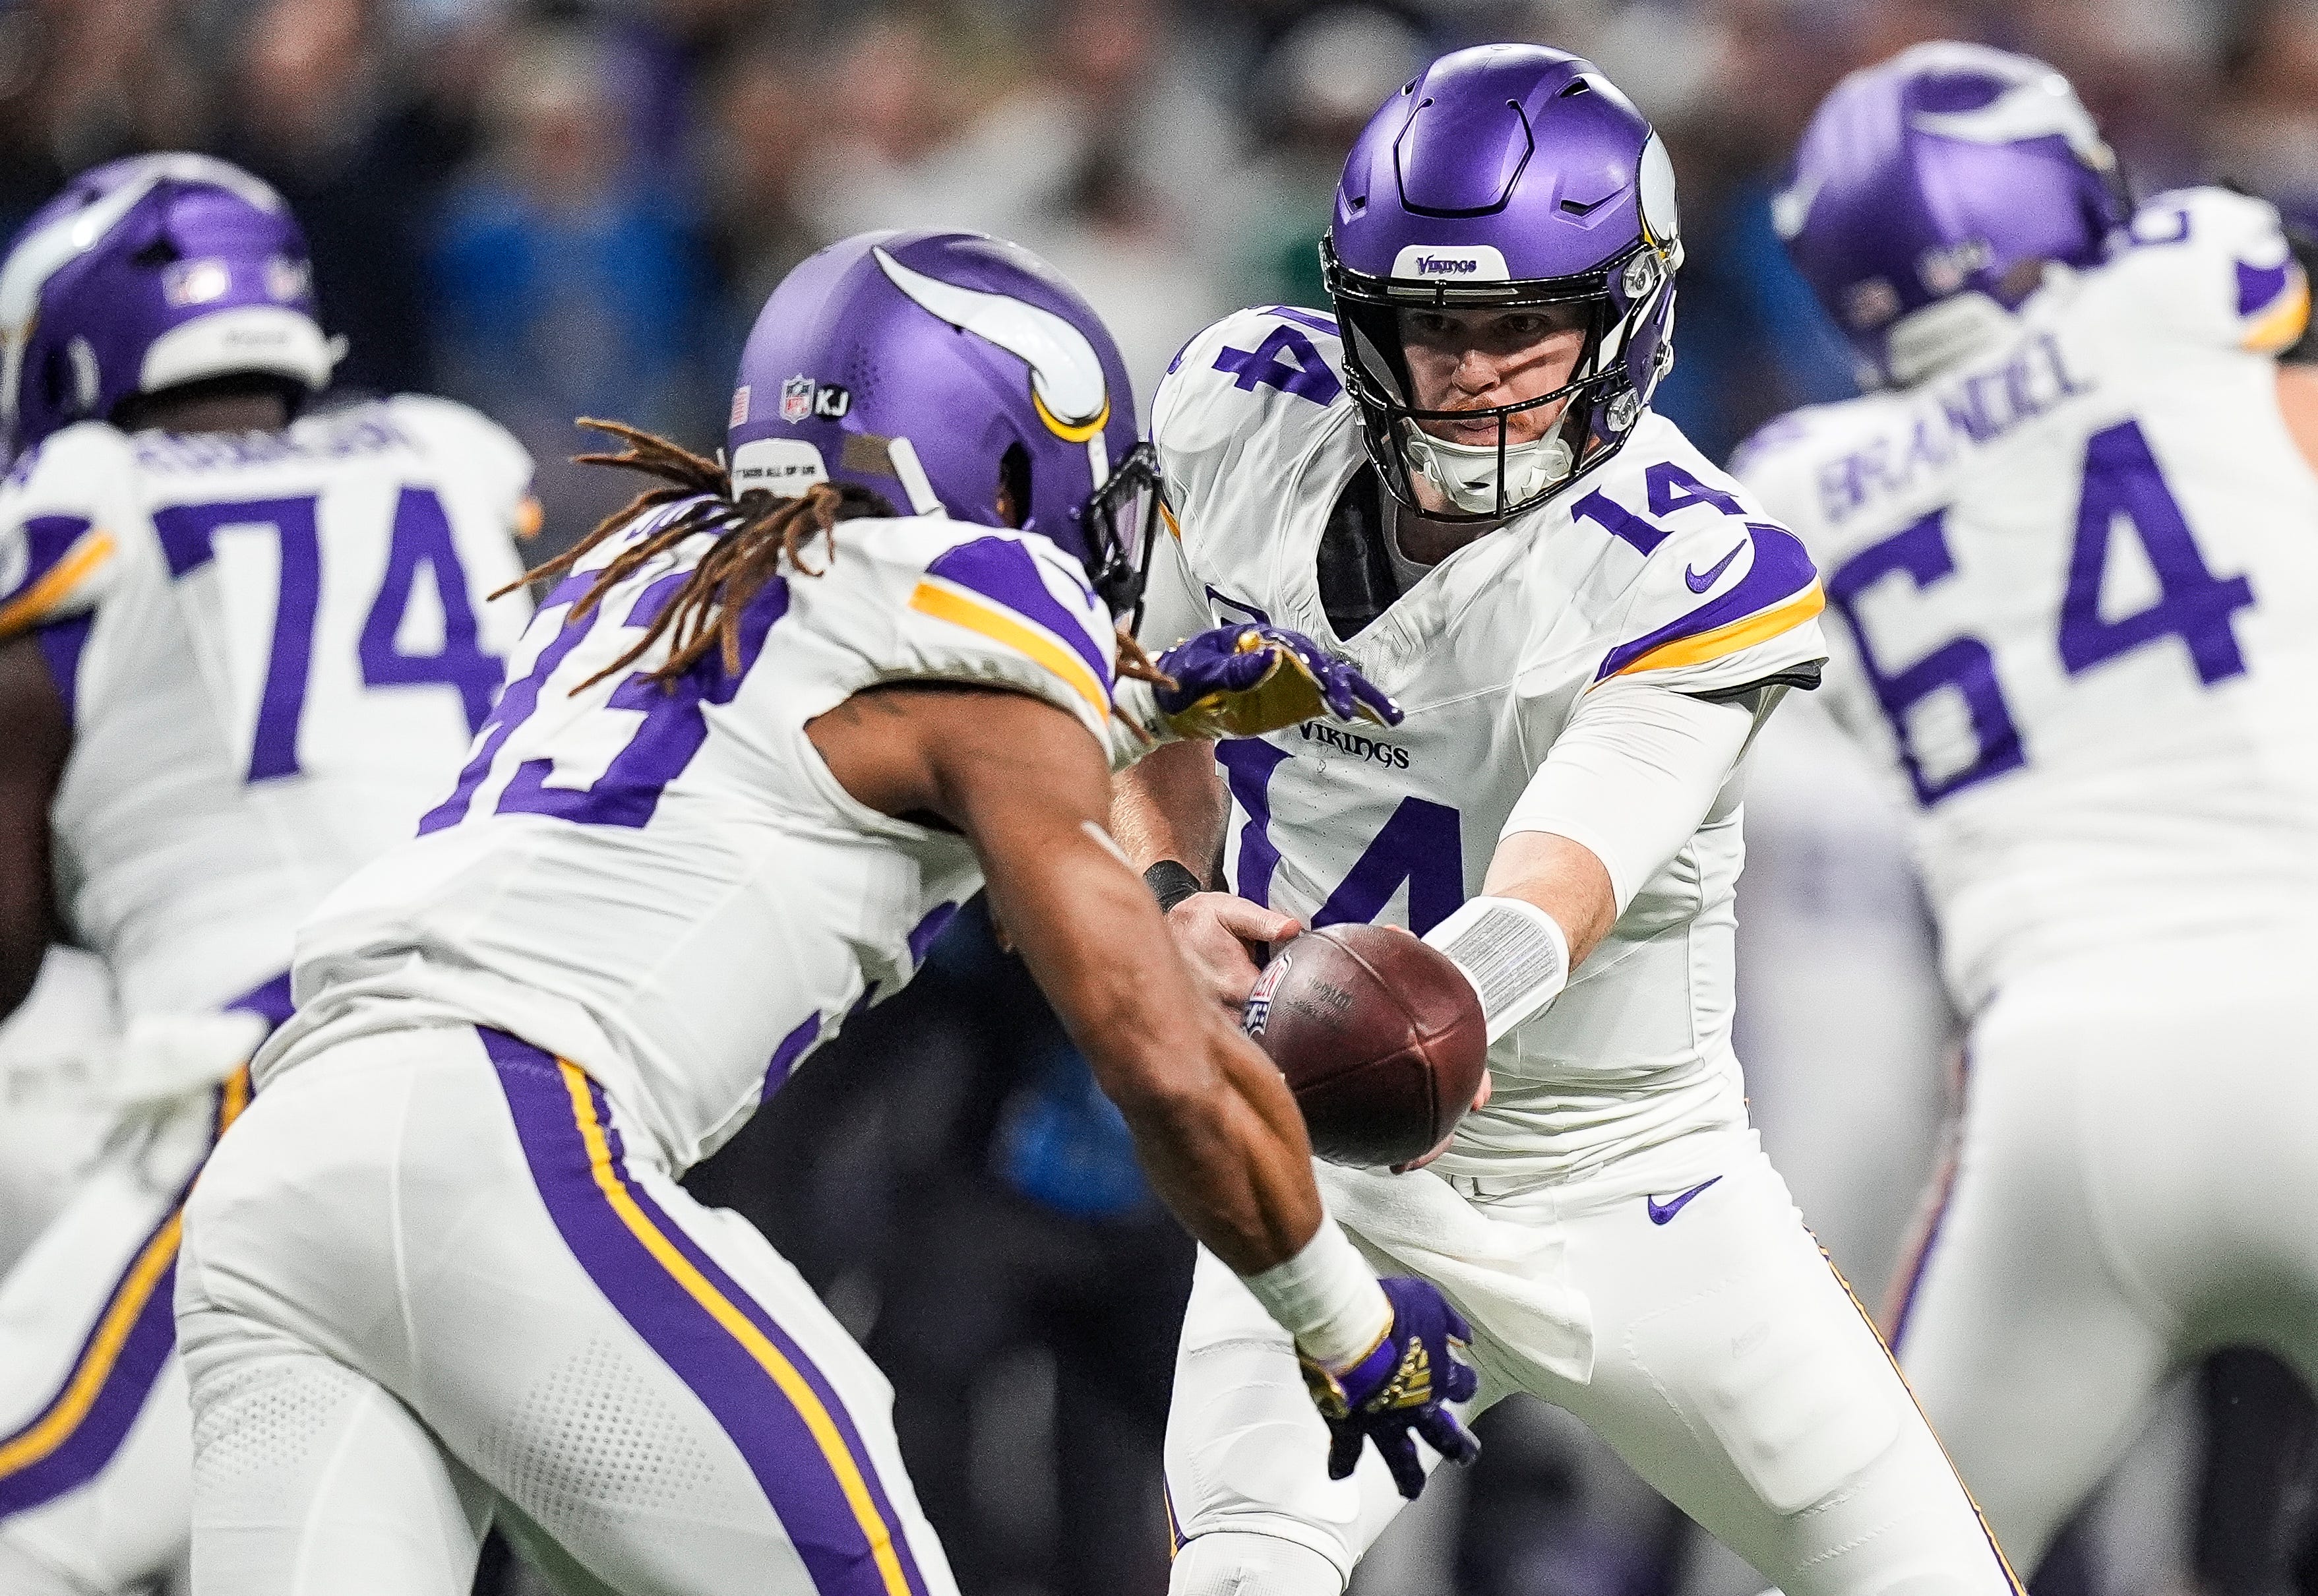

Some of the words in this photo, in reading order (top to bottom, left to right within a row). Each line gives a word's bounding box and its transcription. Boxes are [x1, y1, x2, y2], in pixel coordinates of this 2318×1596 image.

[814, 388, 849, 417] KJ
[1571, 462, 1747, 557] 14
[152, 487, 505, 785] 74
[1828, 419, 2256, 806] 64
[1215, 737, 1465, 971] 14
